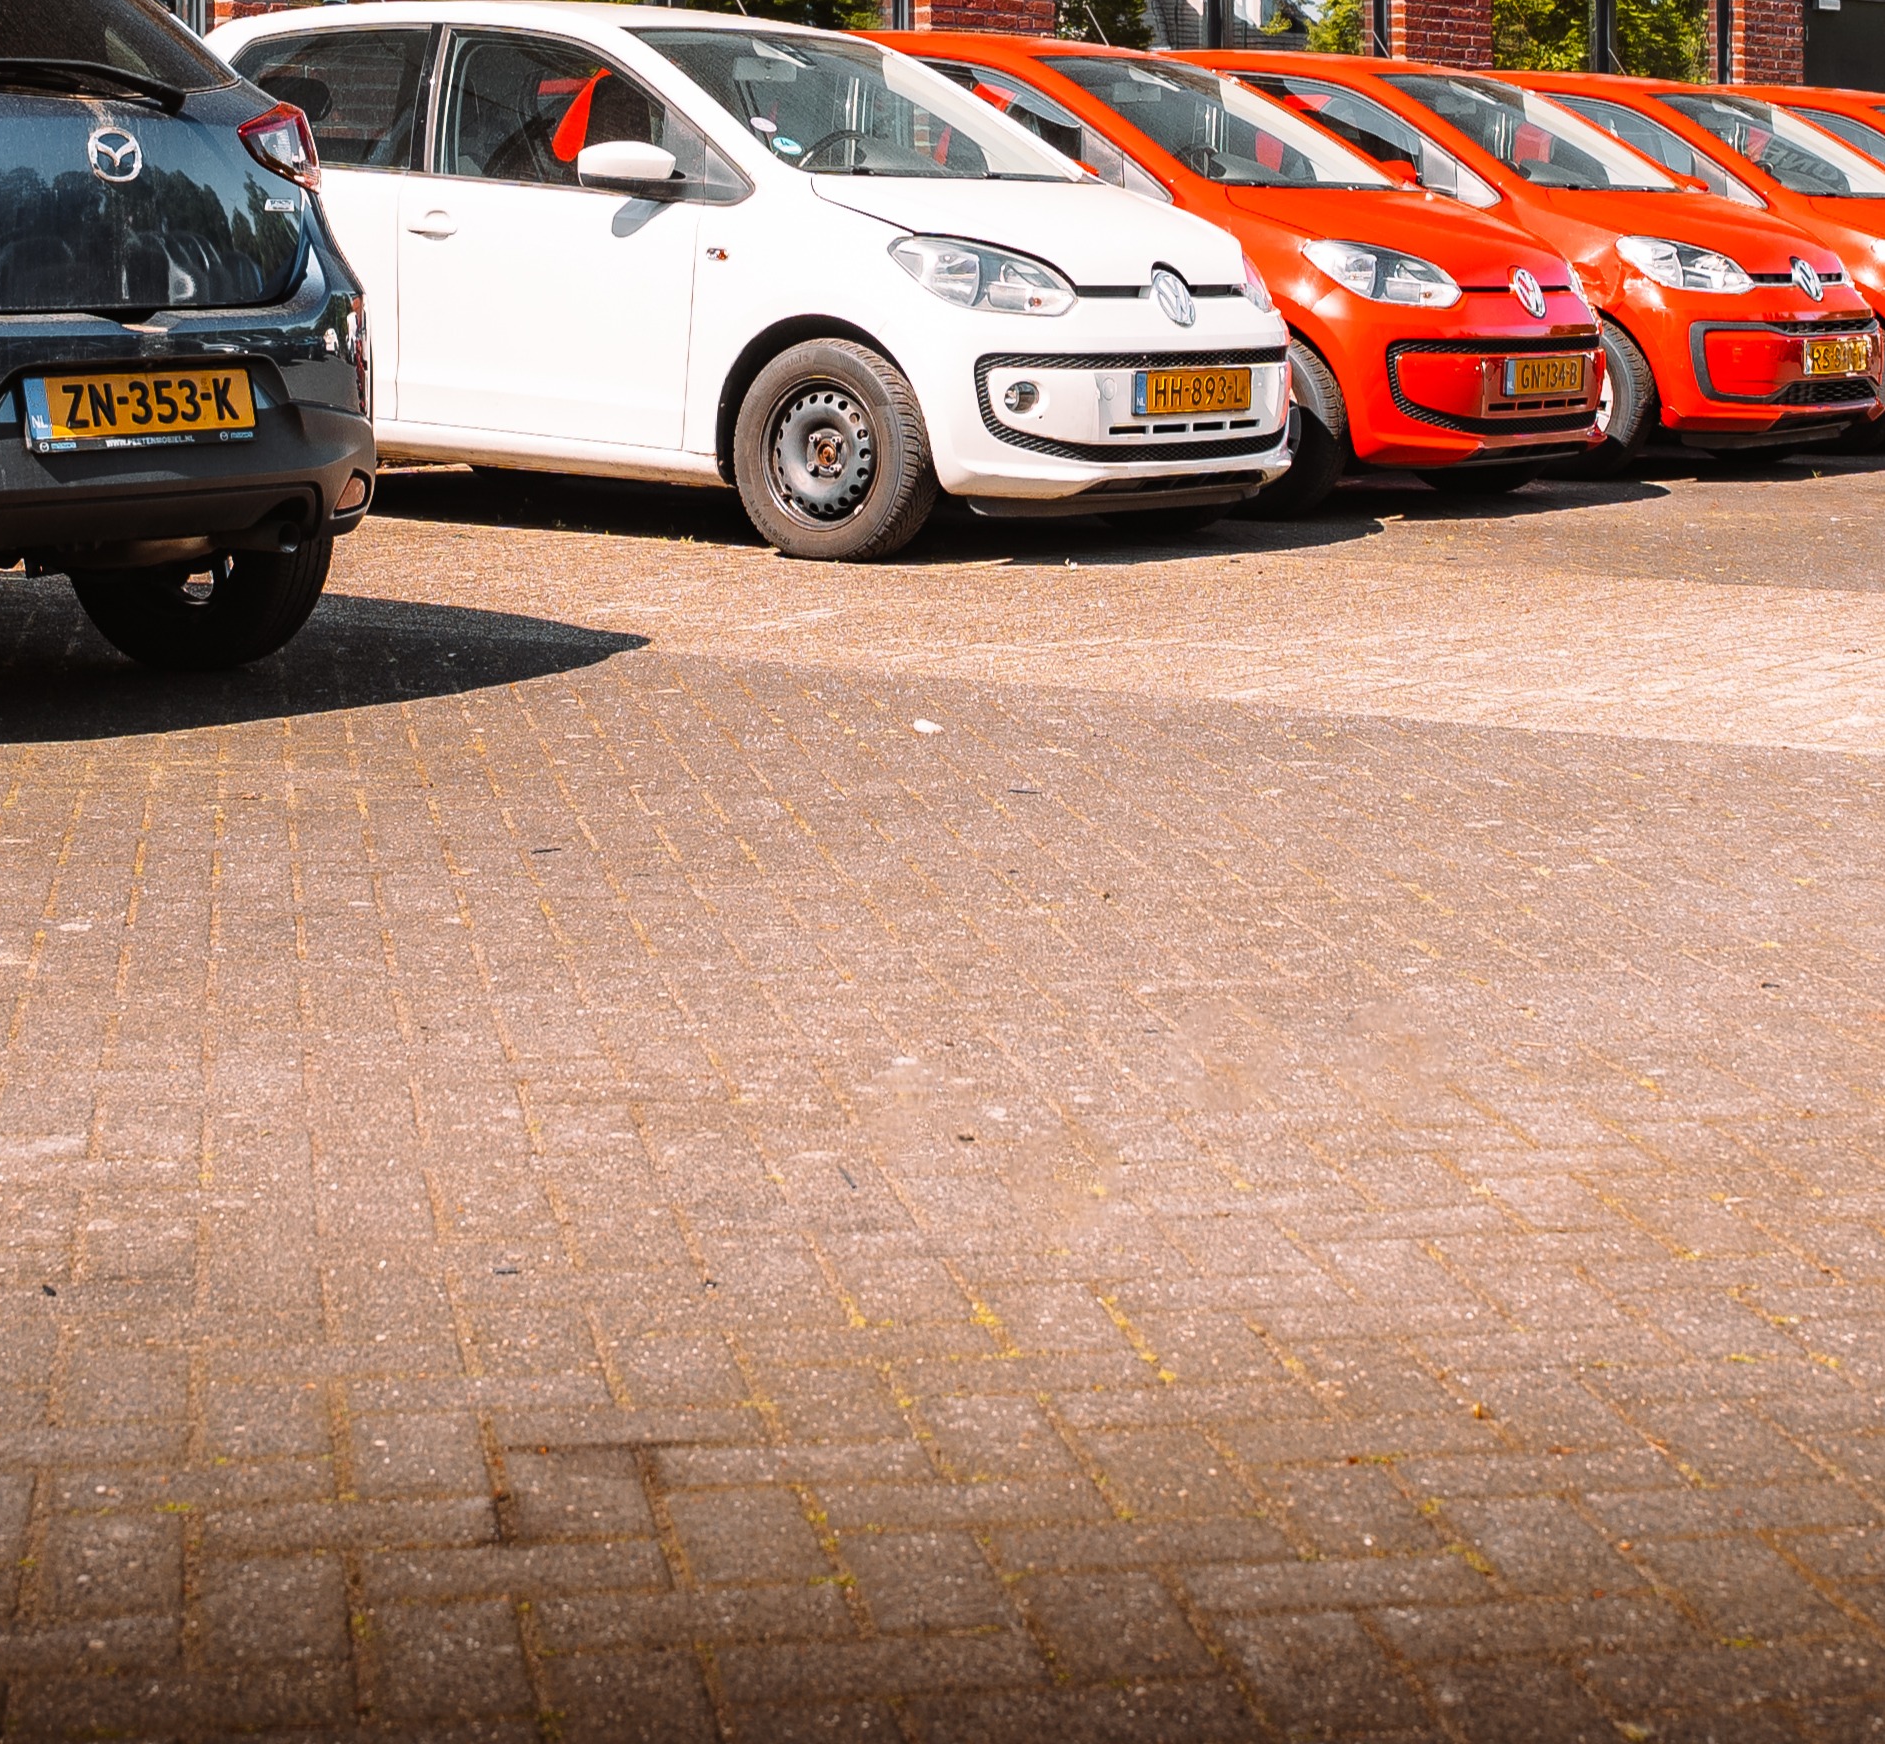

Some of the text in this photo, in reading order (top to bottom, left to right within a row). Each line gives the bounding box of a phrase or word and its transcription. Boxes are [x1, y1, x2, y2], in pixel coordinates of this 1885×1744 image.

[1521, 360, 1577, 389] GN-134-B
[61, 377, 240, 428] ZN-353-K
[1136, 397, 1145, 407] NL
[1153, 375, 1243, 408] HH-893-L
[31, 415, 49, 429] NL
